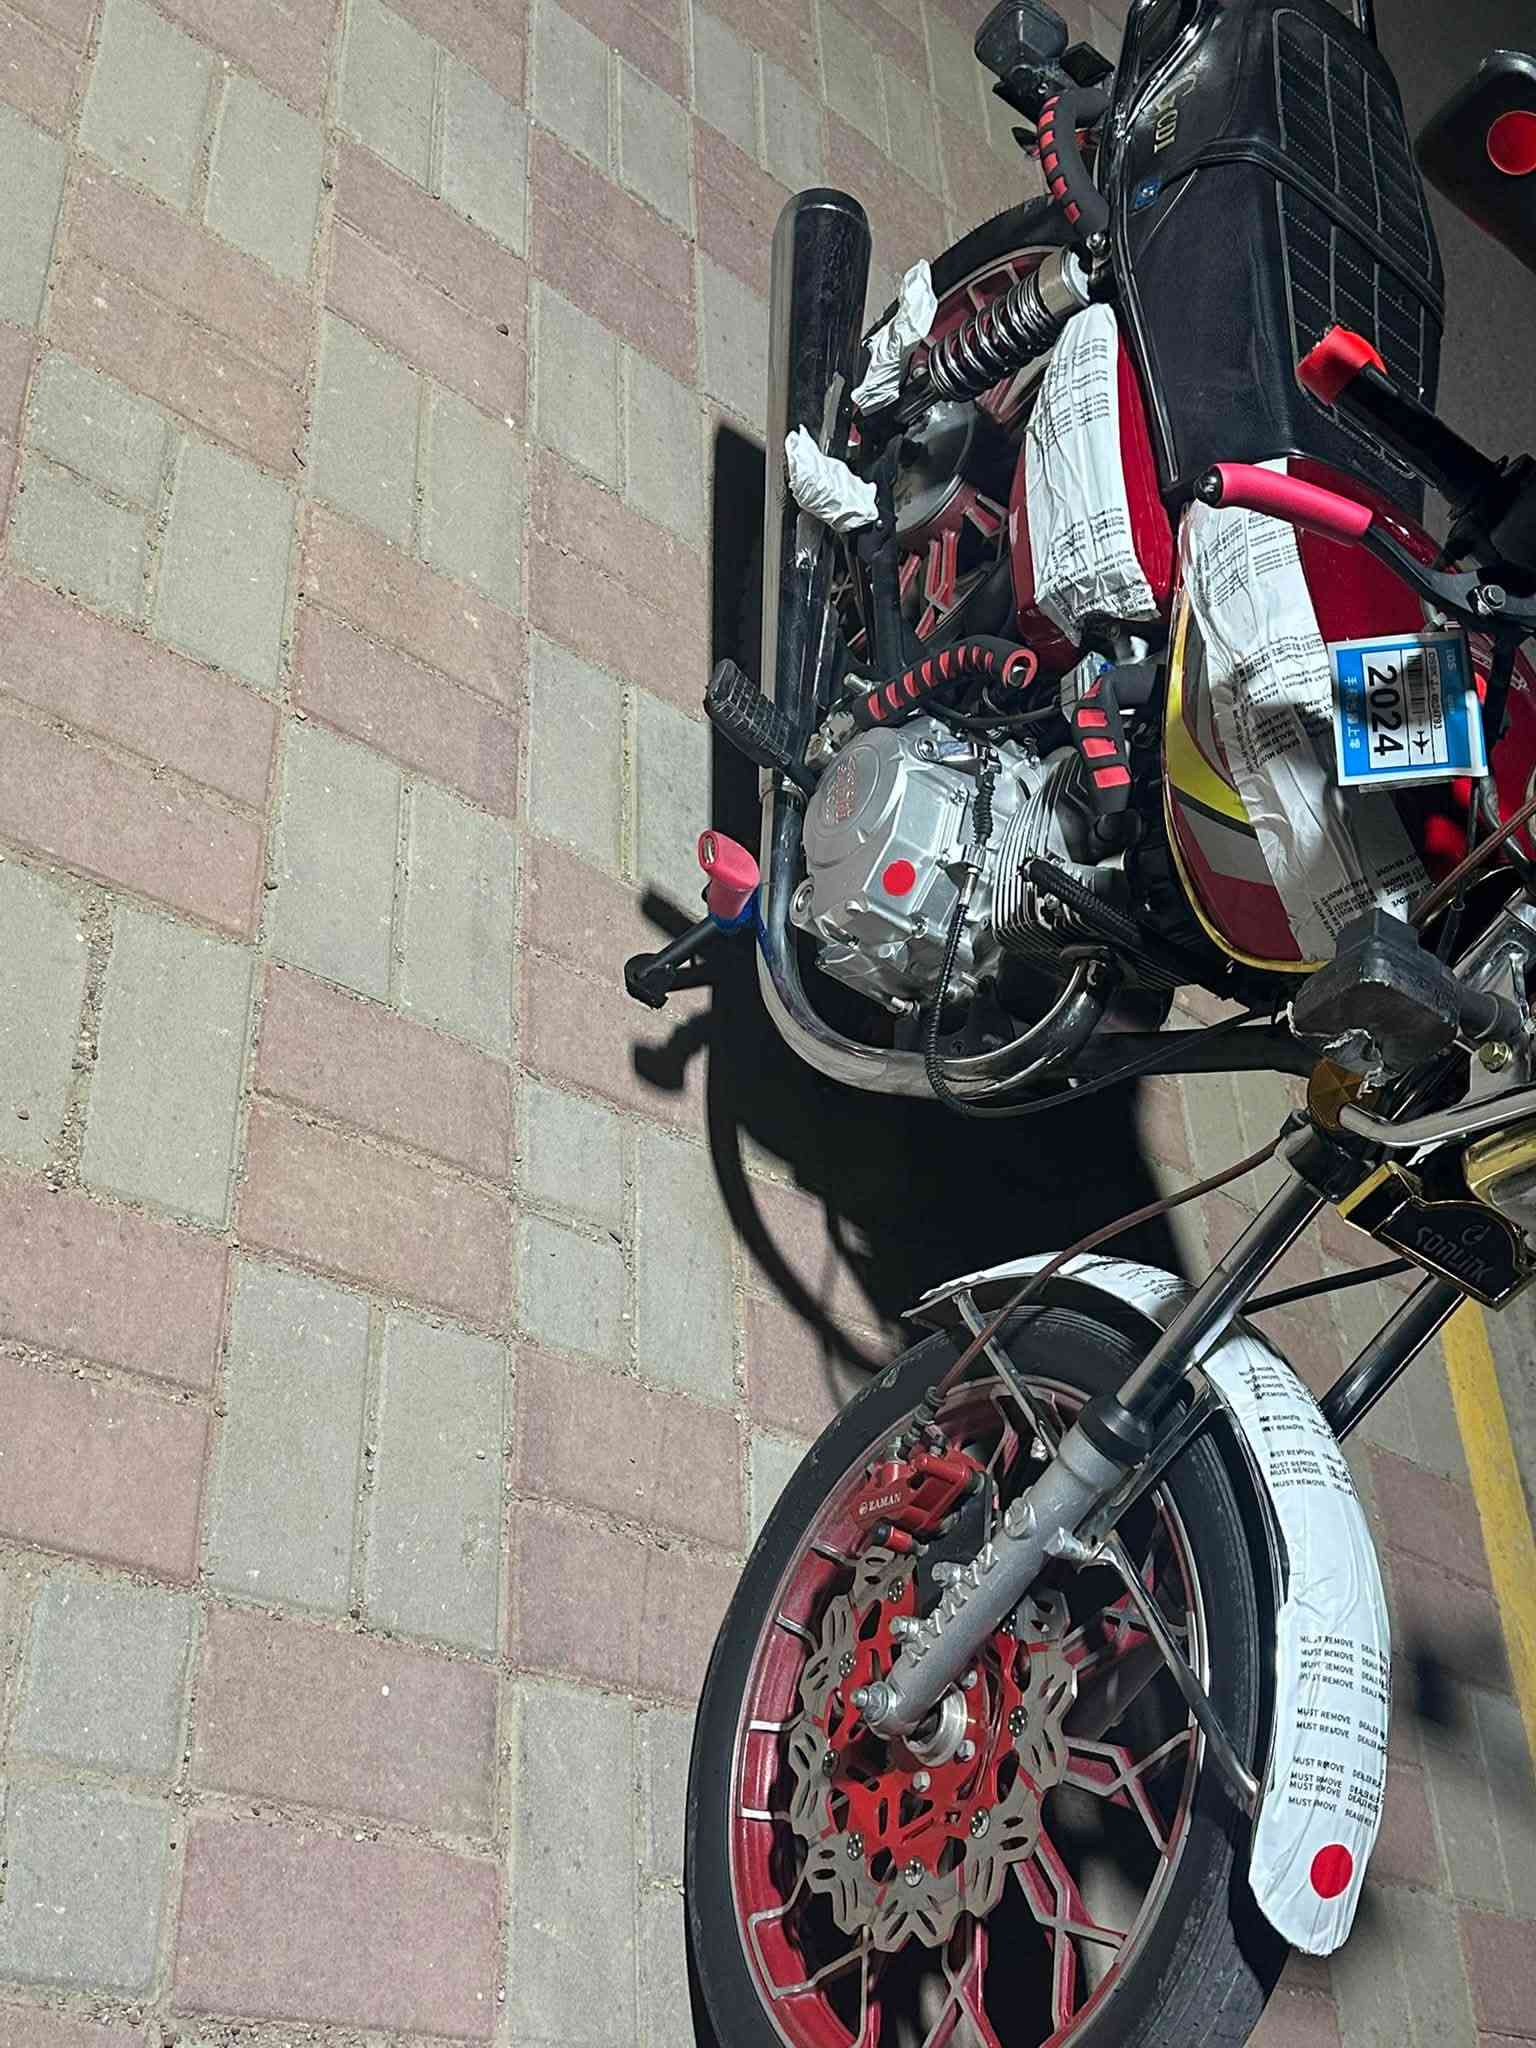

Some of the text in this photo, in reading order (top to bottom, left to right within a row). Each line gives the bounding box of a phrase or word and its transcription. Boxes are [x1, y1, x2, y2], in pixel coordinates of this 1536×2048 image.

[1153, 108, 1178, 154] CDI
[1367, 664, 1404, 756] 2024
[1272, 1478, 1327, 1488] MUST REMOVE
[1324, 1635, 1354, 1649] REMOVE
[1300, 1648, 1322, 1657] MUST
[1324, 1649, 1354, 1663] REMOVE
[1322, 1675, 1354, 1690] REMOVE
[1296, 1706, 1320, 1717] MUST
[1320, 1710, 1351, 1725] REMOVE
[1296, 1721, 1318, 1731] MUST
[1292, 1754, 1315, 1766] MUST
[1290, 1770, 1314, 1783] MUST
[1289, 1780, 1312, 1792] MUST
[1288, 1795, 1312, 1807] MUST
